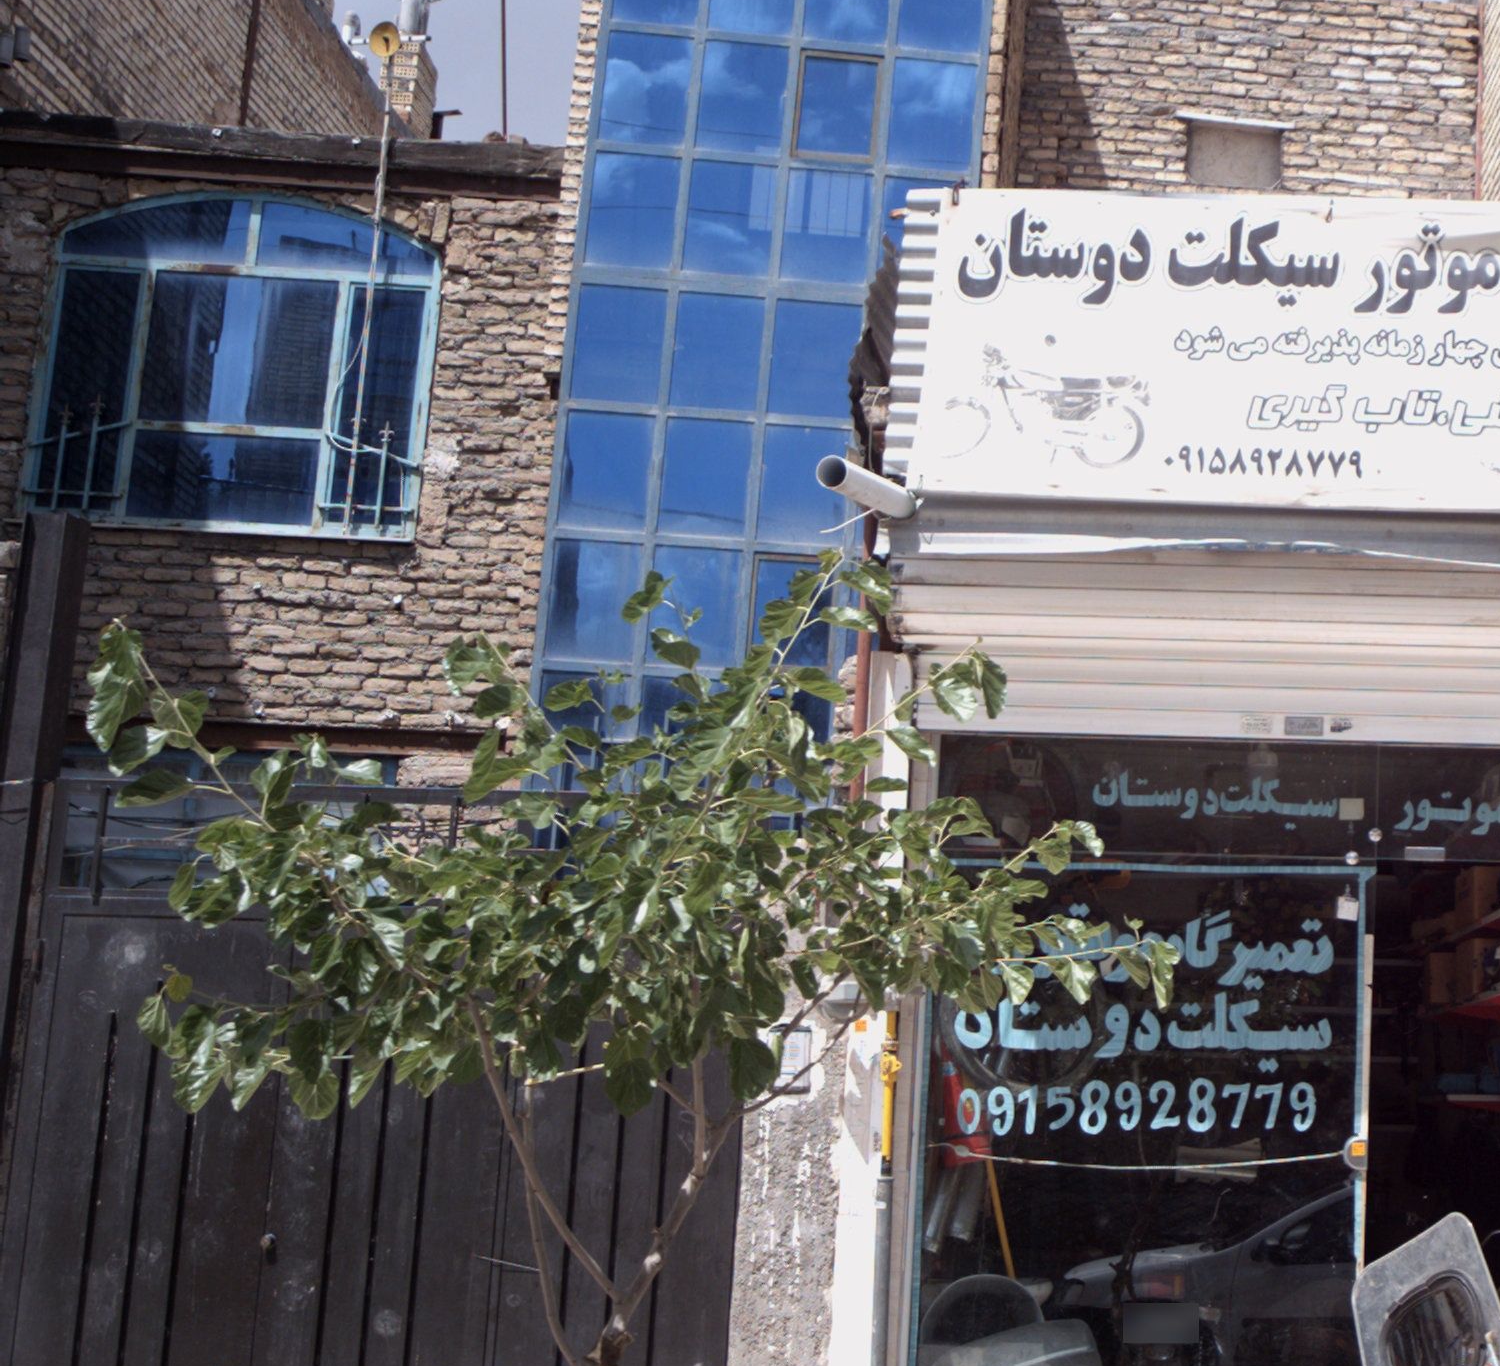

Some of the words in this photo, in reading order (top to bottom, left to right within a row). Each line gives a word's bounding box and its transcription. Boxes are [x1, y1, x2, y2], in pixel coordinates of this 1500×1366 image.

[957, 208, 1151, 305] دوستان
[1168, 216, 1340, 308] سیکلت
[1353, 223, 1500, 314] موتور
[1272, 326, 1361, 366] پذیرفته
[1363, 329, 1426, 366] زمانه
[1427, 329, 1488, 370] چهار
[1246, 384, 1348, 432] گیری
[1164, 445, 1363, 478] ۰۹۱۵۸۹۲۸۷۷۹
[1091, 769, 1219, 819] دوستان
[1220, 776, 1338, 830] سیکلت
[1166, 992, 1333, 1074] سیکلت
[956, 1078, 1317, 1136] 09158928779
